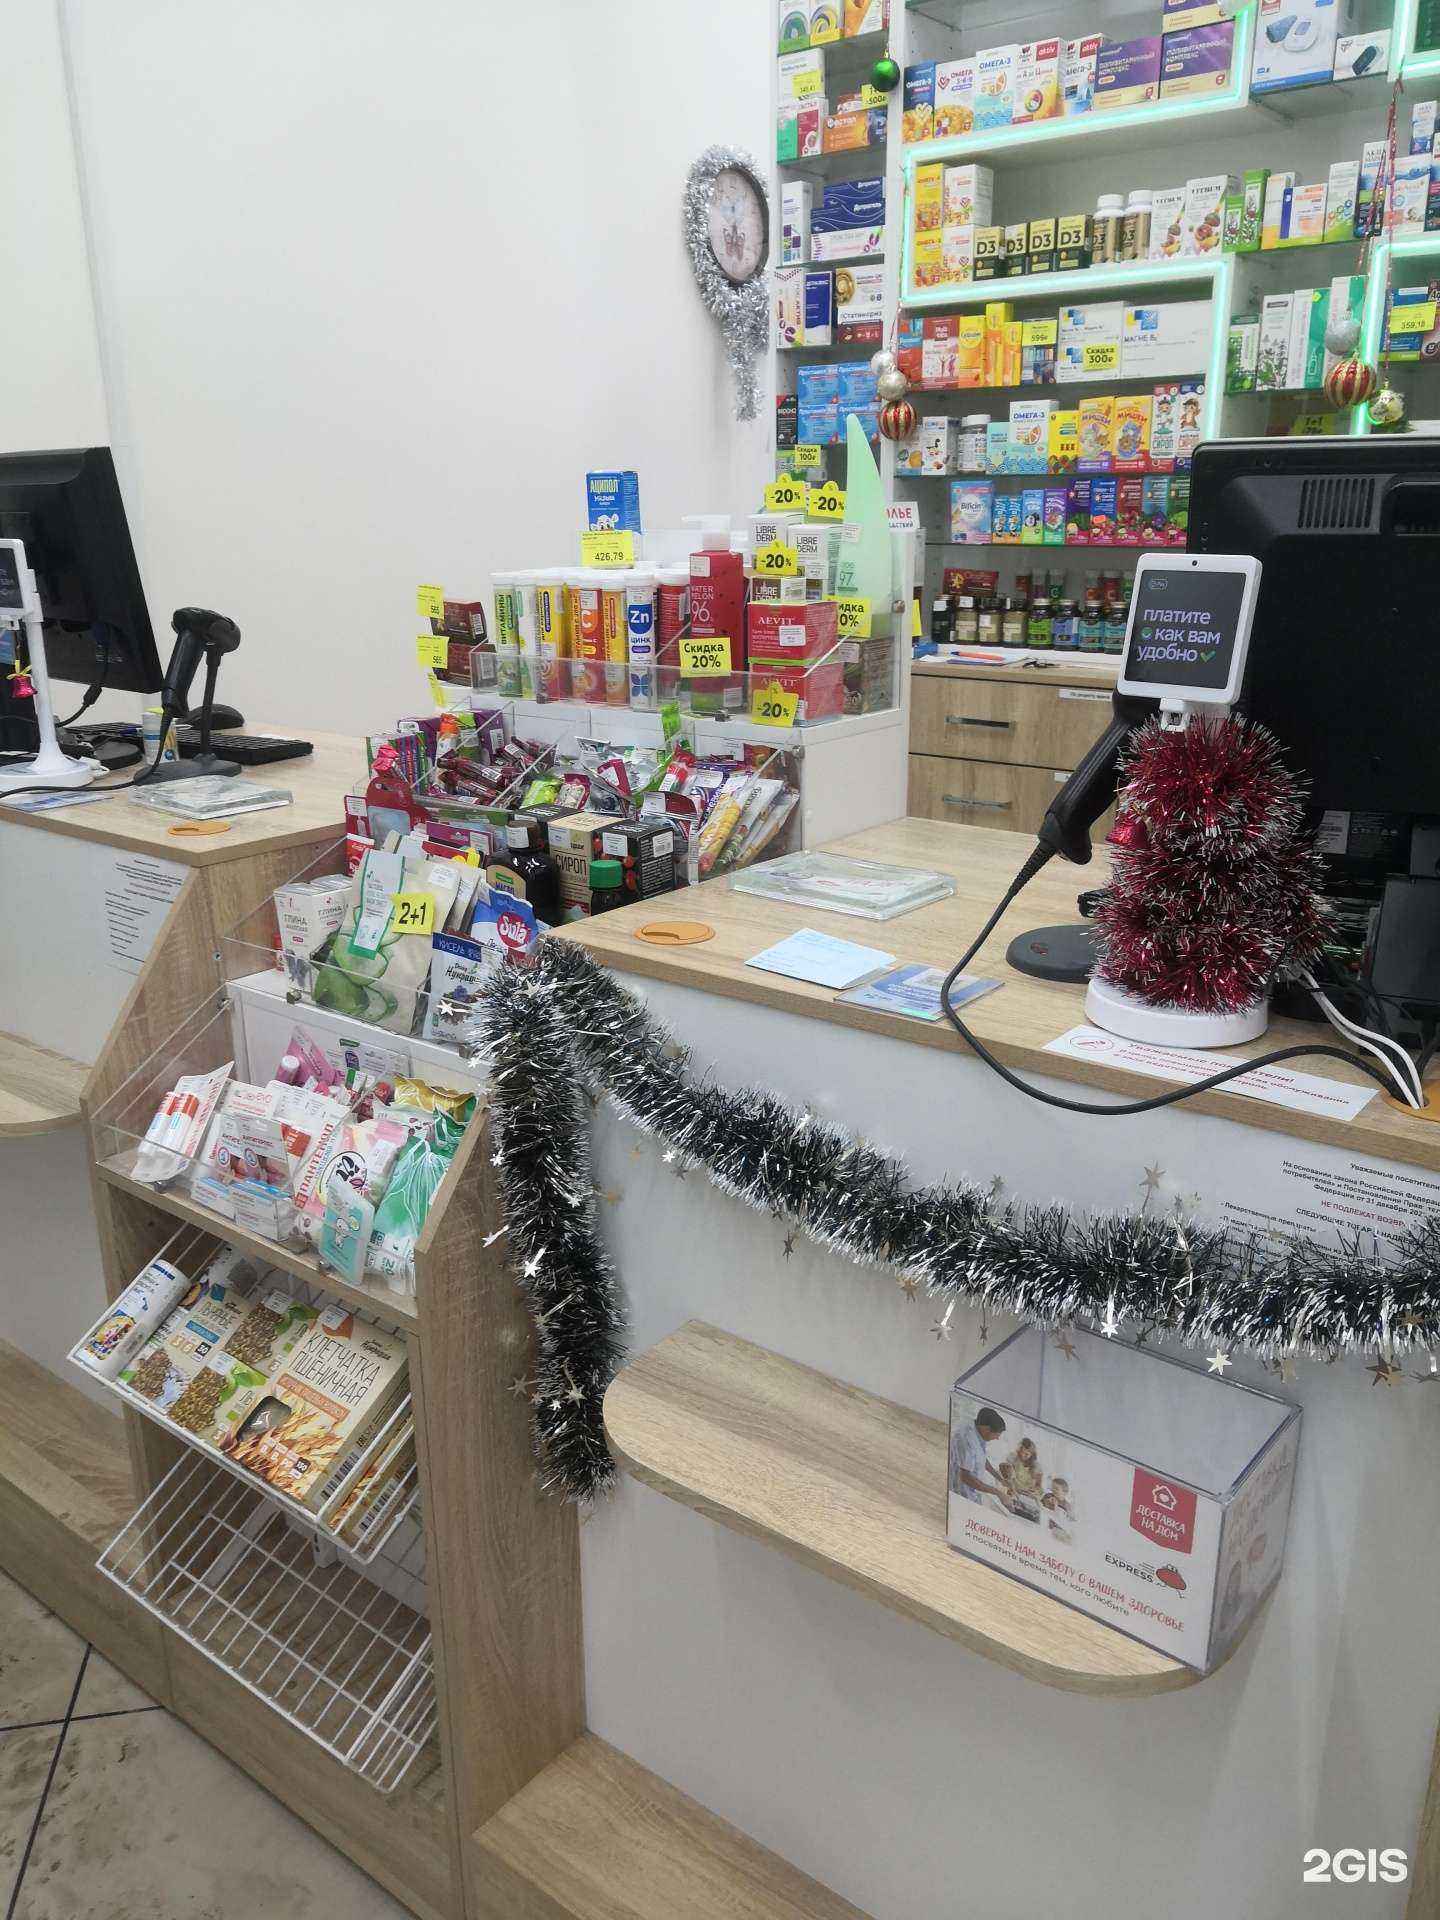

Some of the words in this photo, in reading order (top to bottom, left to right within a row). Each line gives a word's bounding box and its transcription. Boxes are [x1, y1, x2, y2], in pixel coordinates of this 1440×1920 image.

[1032, 234, 1051, 249] D3
[1060, 229, 1082, 245] D3
[976, 241, 996, 255] D3
[1086, 346, 1115, 355] Скидка
[1013, 411, 1045, 420] ОМЕГА-3
[755, 525, 777, 534] LIBRE
[796, 536, 818, 545] LIBRE
[796, 545, 818, 553] DERM
[761, 553, 792, 568] -20%
[755, 586, 778, 596] LIBRE
[691, 600, 710, 622] 96
[838, 602, 864, 613] идка
[630, 610, 650, 624] Zn
[839, 613, 859, 628] 0%
[1143, 608, 1211, 625] платите
[1155, 629, 1185, 643] как
[1188, 630, 1222, 645] вам
[684, 643, 725, 654] Скидка
[1136, 642, 1198, 662] удобно
[692, 654, 721, 669] 20%
[555, 854, 587, 876] СИРОП
[398, 901, 426, 926] 2+1
[1350, 1162, 1394, 1179] Уважаемые
[1282, 1160, 1292, 1168] На
[1293, 1164, 1332, 1179] основании
[1333, 1174, 1358, 1185] закона
[1359, 1180, 1404, 1197] Российской
[1405, 1191, 1440, 1207] Федерац
[1313, 1184, 1355, 1200] Федерации
[1366, 1196, 1375, 1205] 31
[1376, 1201, 1408, 1214] декабря
[1409, 1207, 1423, 1218] 202
[1343, 1183, 1402, 1204] Постановления
[1296, 1207, 1345, 1227] СЛЕДУЮЩИЕ
[1321, 1200, 1331, 1209] НЕ
[1332, 1203, 1376, 1221] ПОДЛЕЖАТ
[303, 1331, 381, 1388] КЛЕТЧАТКА
[288, 1350, 369, 1407] ПШЕНИЧНАЯ
[1135, 1504, 1186, 1535] ДОСТАВКА
[1141, 1517, 1155, 1532] НА
[1155, 1524, 1179, 1541] ДОМ
[965, 1518, 1012, 1548] ДОВЕРЬТЕ
[1015, 1543, 1036, 1559] НАМ
[1039, 1552, 1075, 1578] ЗАБОТУ
[1078, 1572, 1086, 1583] О
[1088, 1577, 1125, 1602] ВАШЕМ
[1128, 1597, 1185, 1633] ЗДОРОВЬЕ
[972, 1536, 1017, 1560] посвятить
[1019, 1557, 1048, 1576] время
[1070, 1582, 1091, 1598] кого
[1093, 1593, 1129, 1617] любите
[1104, 1553, 1154, 1583] EXPRESS
